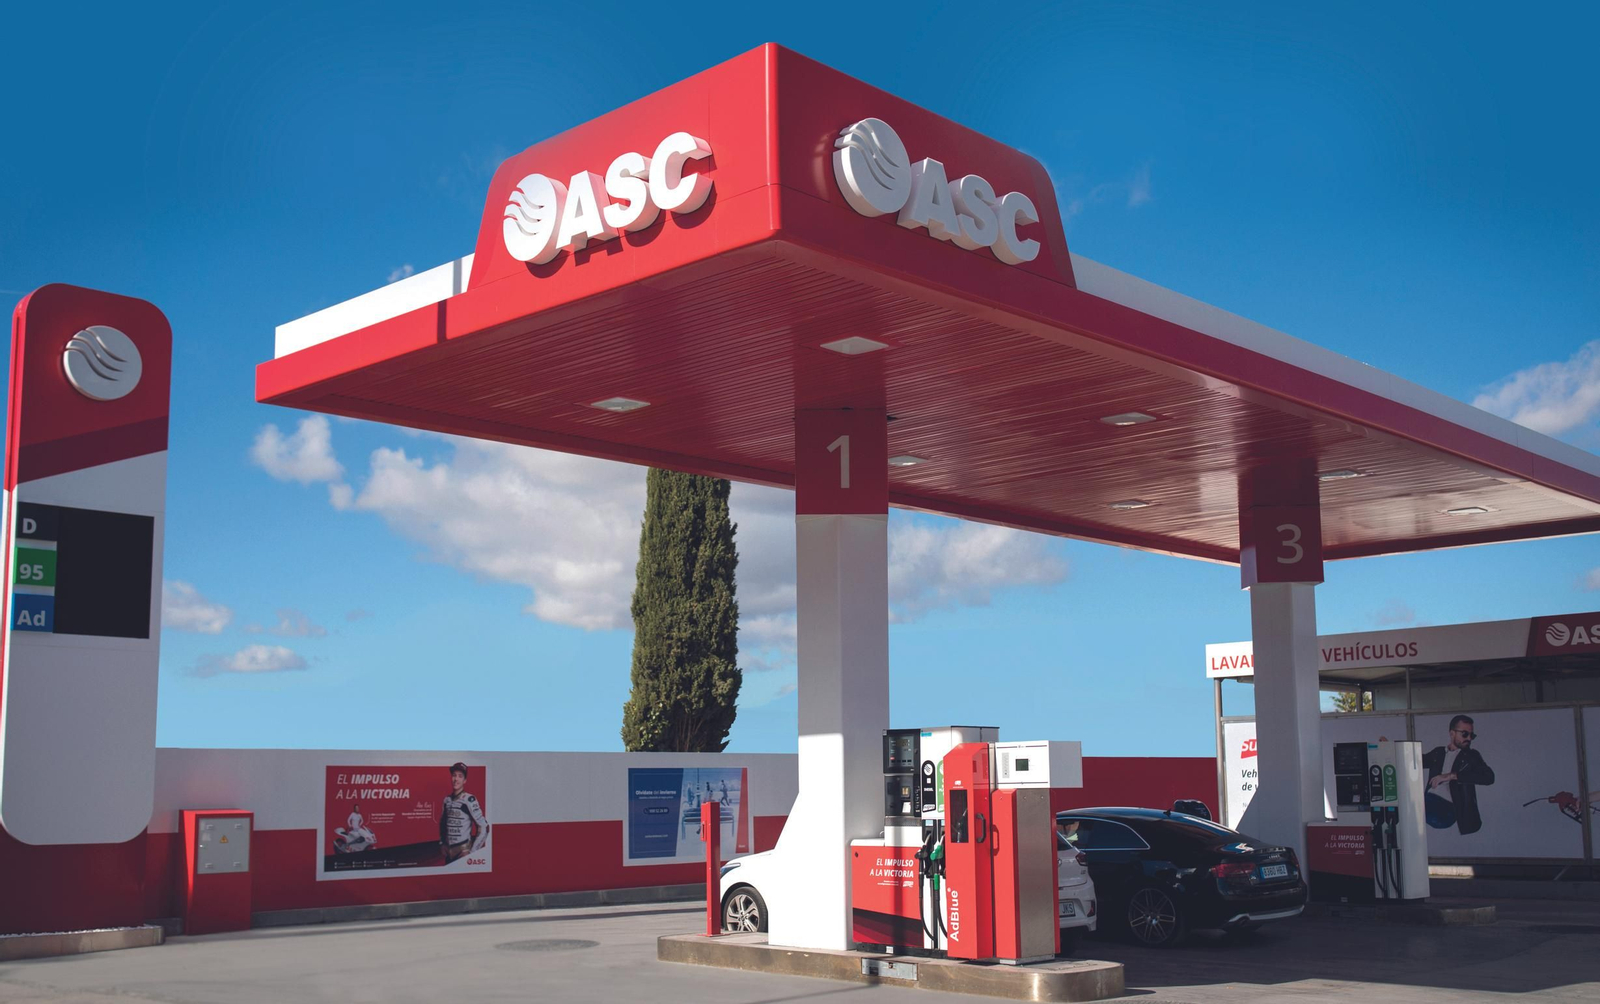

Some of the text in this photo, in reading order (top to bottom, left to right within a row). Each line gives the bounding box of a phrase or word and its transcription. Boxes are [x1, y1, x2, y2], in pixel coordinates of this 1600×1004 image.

[556, 131, 712, 252] ASC
[898, 157, 1041, 265] ASC
[826, 435, 850, 489] 1
[22, 518, 37, 534] D
[1276, 523, 1303, 564] 3
[19, 563, 44, 580] 95
[16, 609, 46, 627] Ad
[1211, 641, 1418, 670] LAVA VEHÍCULOS
[337, 774, 400, 785] EL IMPULSO
[1241, 782, 1252, 791] de
[335, 788, 410, 800] A LA VICTORIA
[876, 858, 914, 867] EL IMPULSO
[875, 869, 883, 877] LA
[883, 870, 914, 878] VICTORIA
